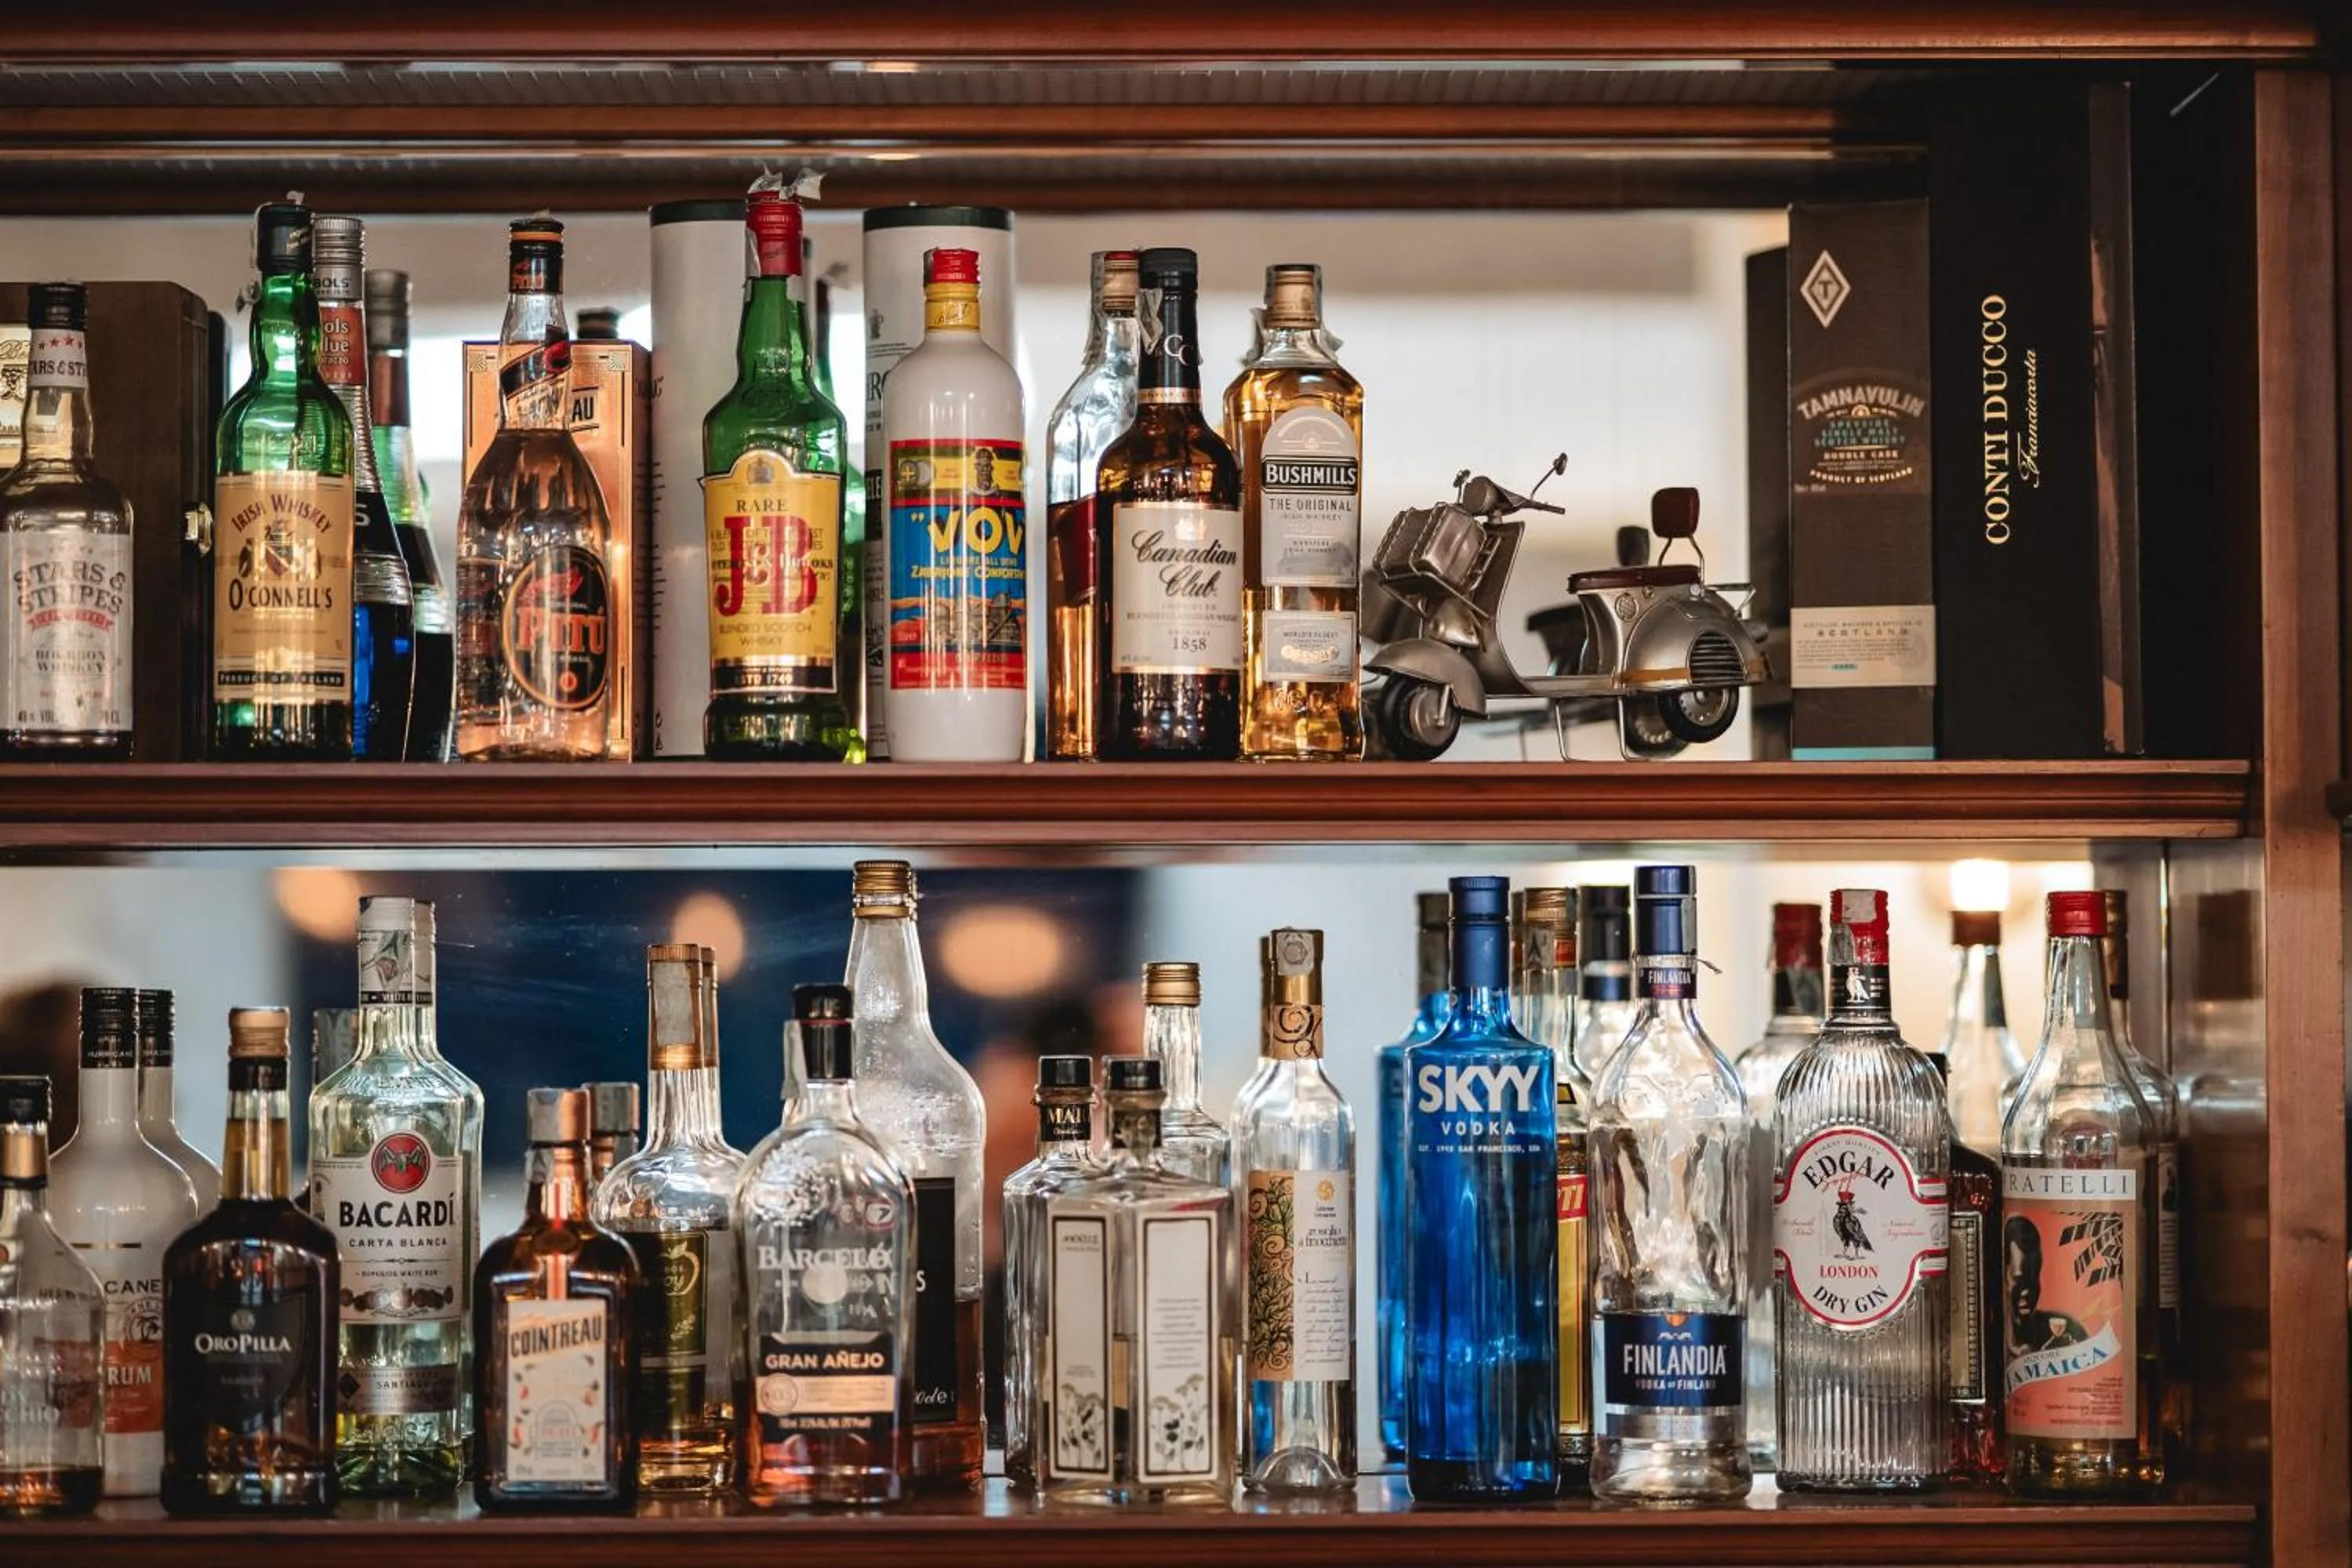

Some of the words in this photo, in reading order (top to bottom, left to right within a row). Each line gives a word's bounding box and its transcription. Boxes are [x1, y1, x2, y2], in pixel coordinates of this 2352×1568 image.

[324, 318, 349, 333] ols
[323, 336, 349, 352] lue
[1980, 293, 2008, 422] DUCCO
[1796, 385, 1926, 420] TAMNAVULIN
[1265, 463, 1357, 485] BUSHMILLS
[1983, 430, 2010, 545] CONTI
[231, 499, 267, 533] IRISH
[270, 493, 334, 534] WHISKEY
[735, 499, 789, 514] RARE
[1269, 498, 1291, 510] THE
[1296, 499, 1352, 512] ORIGINAL
[1131, 529, 1237, 565] Canadian
[13, 560, 105, 590] STARS
[1159, 564, 1221, 598] Club
[17, 585, 123, 615] STRIPES
[228, 578, 333, 612] O'CONNELL'S
[1173, 637, 1207, 653] 1858
[1817, 629, 1908, 637] SCOTLAND
[1417, 1063, 1541, 1114] SKYY
[1440, 1120, 1516, 1136] VODKA
[1802, 1150, 1895, 1191] EDGAR
[339, 1191, 456, 1229] BACARDÍ
[349, 1239, 394, 1248] CARTA
[400, 1237, 448, 1248] BLANCA
[1819, 1264, 1879, 1279] LONDON
[1812, 1285, 1849, 1314] DRY
[1854, 1284, 1889, 1313] GIN
[510, 1315, 602, 1358] COINTREAU
[764, 1353, 819, 1369] GRAN
[823, 1348, 885, 1369] AÑEJO
[1624, 1344, 1726, 1376] FINLANDIA
[107, 1365, 151, 1386] RUM
